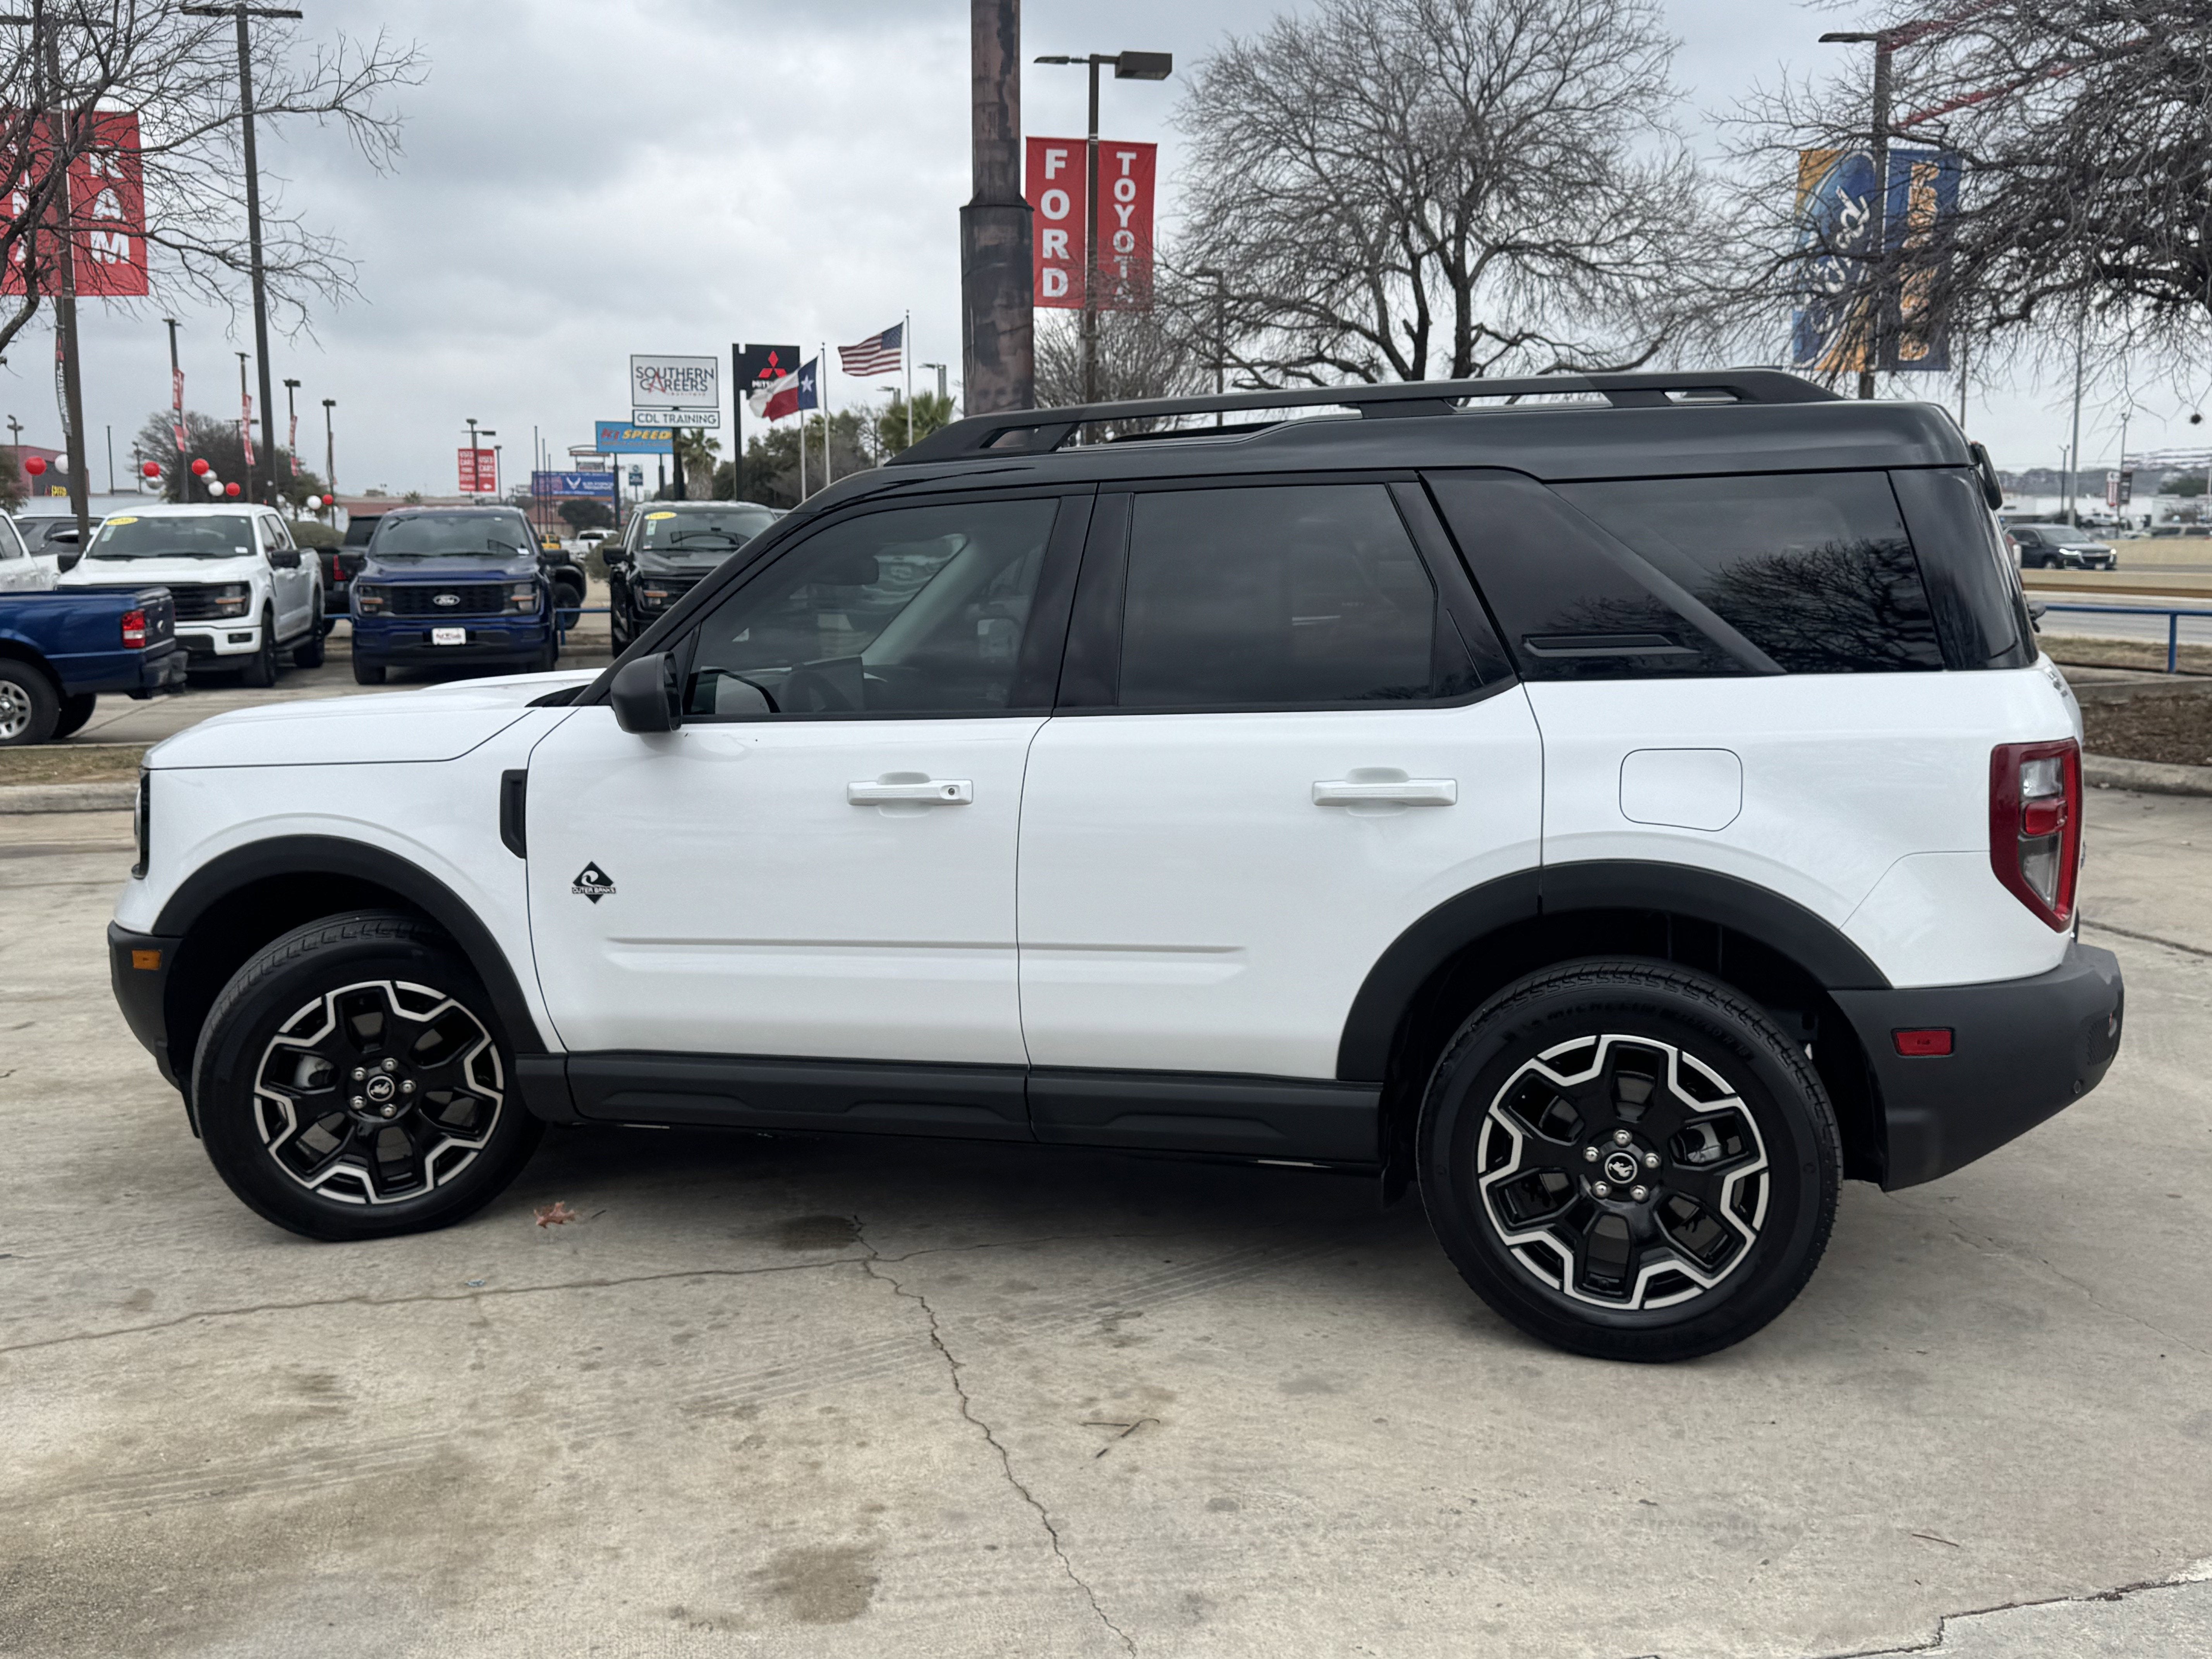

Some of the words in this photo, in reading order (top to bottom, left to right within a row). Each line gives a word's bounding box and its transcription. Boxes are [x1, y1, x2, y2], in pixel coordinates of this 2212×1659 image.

[1041, 149, 1070, 297] FORD
[635, 366, 714, 380] SOUTHERN
[640, 377, 708, 393] CAREERS
[637, 413, 659, 423] CDL
[663, 413, 716, 424] TRAINING
[622, 429, 673, 440] SPEED
